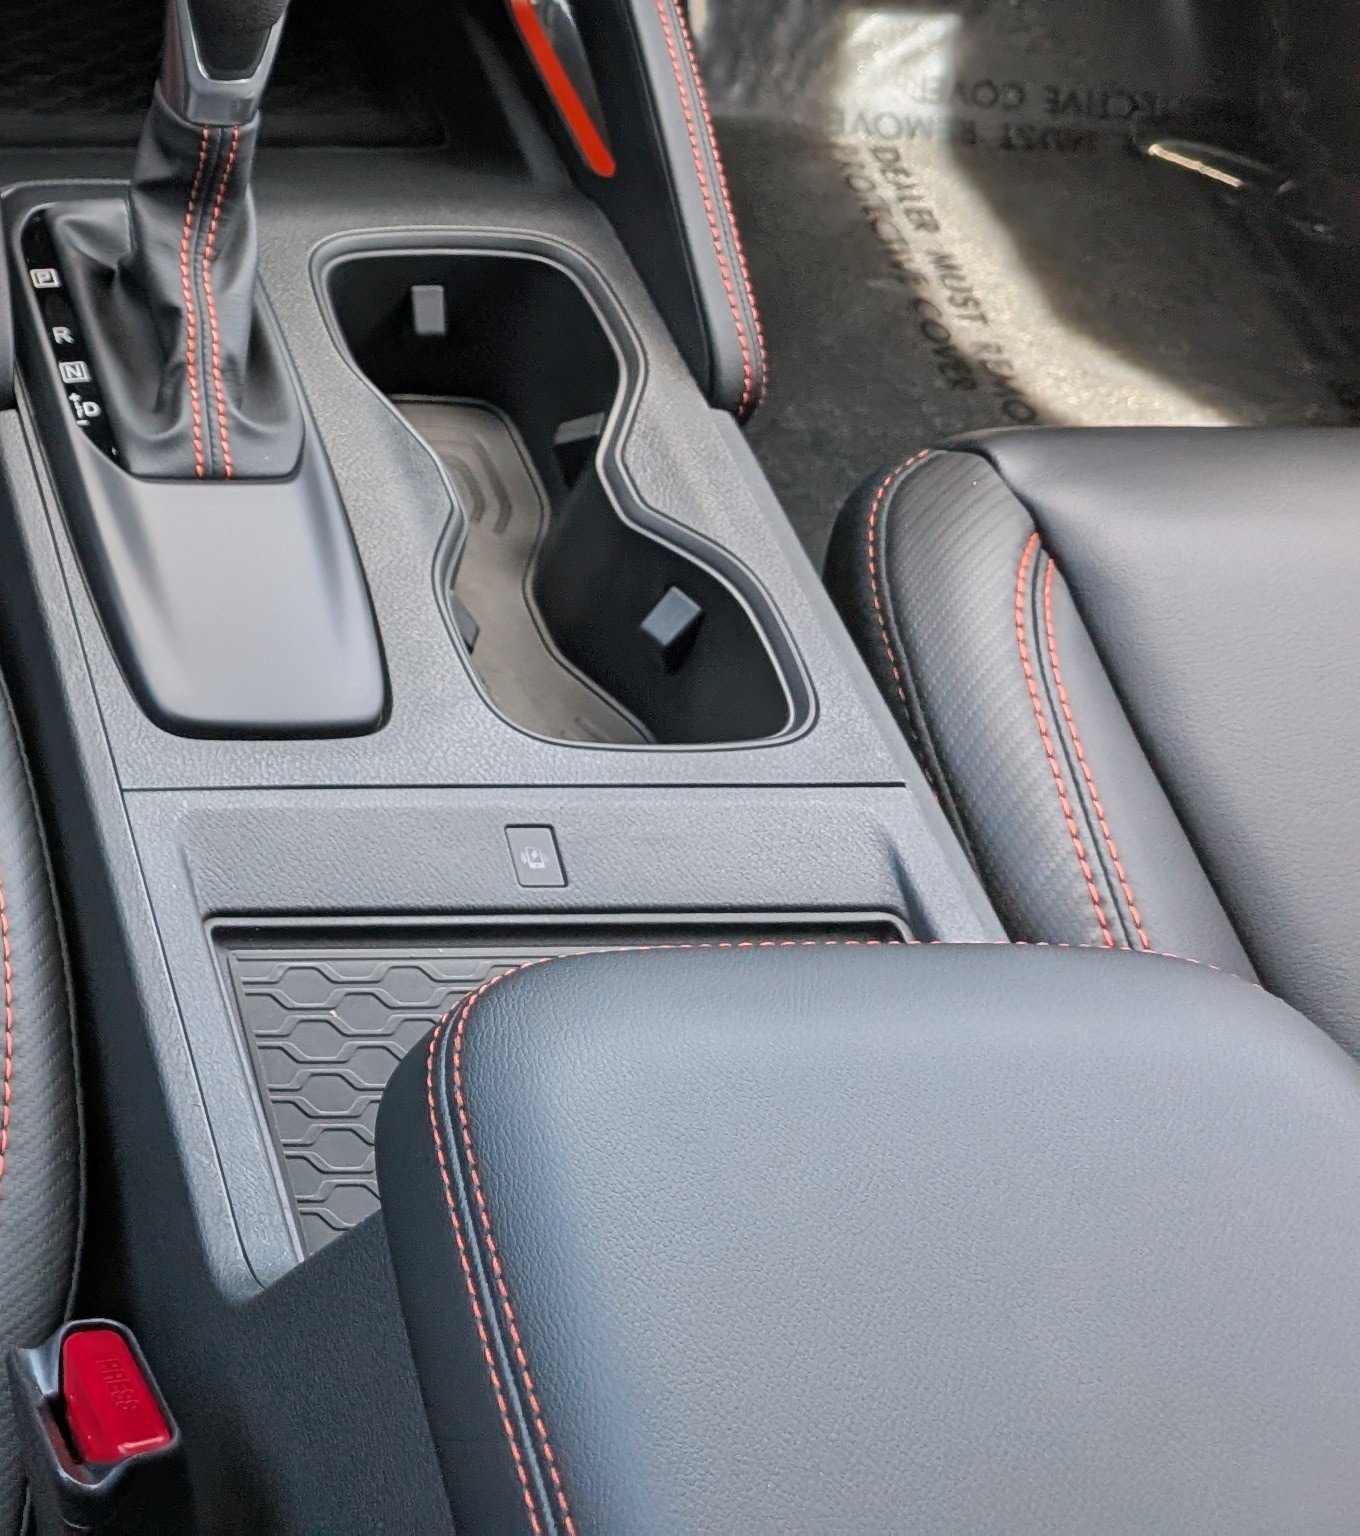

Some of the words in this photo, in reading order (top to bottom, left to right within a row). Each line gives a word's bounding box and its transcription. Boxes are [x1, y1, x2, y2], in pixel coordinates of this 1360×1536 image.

[52, 327, 74, 345] R
[64, 365, 85, 379] N
[83, 401, 101, 417] D
